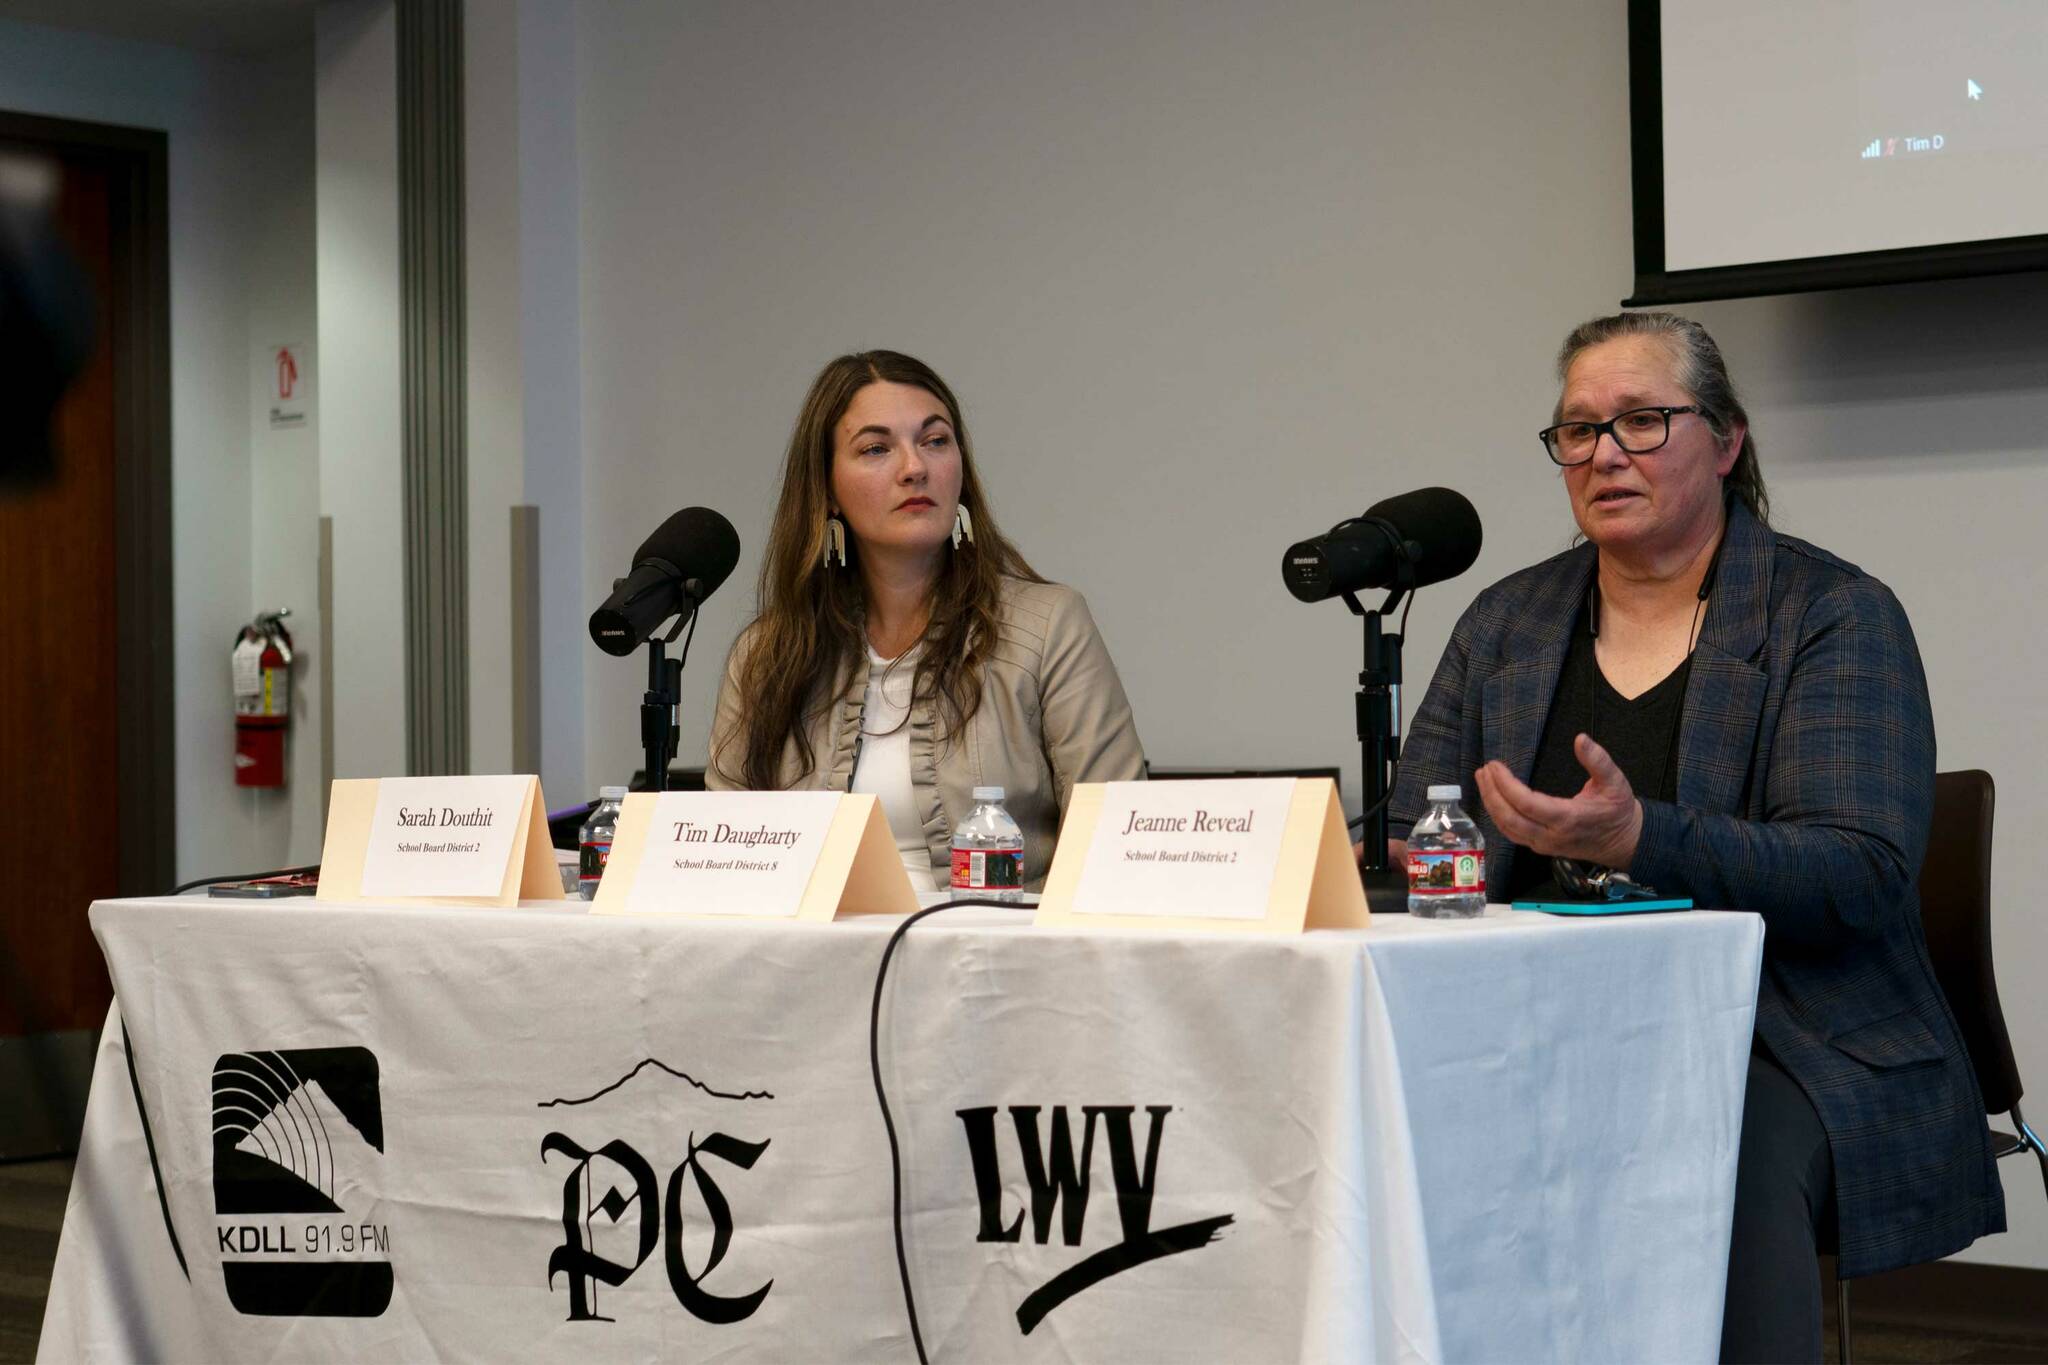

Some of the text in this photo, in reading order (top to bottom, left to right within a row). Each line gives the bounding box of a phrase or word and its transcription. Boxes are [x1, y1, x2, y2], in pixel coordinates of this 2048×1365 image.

[1904, 135, 1944, 152] Tim D
[397, 806, 493, 827] Sarah Douthit
[1122, 809, 1254, 836] Jeanne Reveal
[673, 821, 802, 849] Tim Daugharty
[397, 842, 481, 853] School Board District 2
[1124, 850, 1238, 863] School Board District 2
[673, 858, 779, 872] School Board District 8
[955, 1105, 1173, 1249] LWV
[217, 1224, 391, 1253] KDLL 91.9 FM
[540, 1130, 776, 1325] PC
